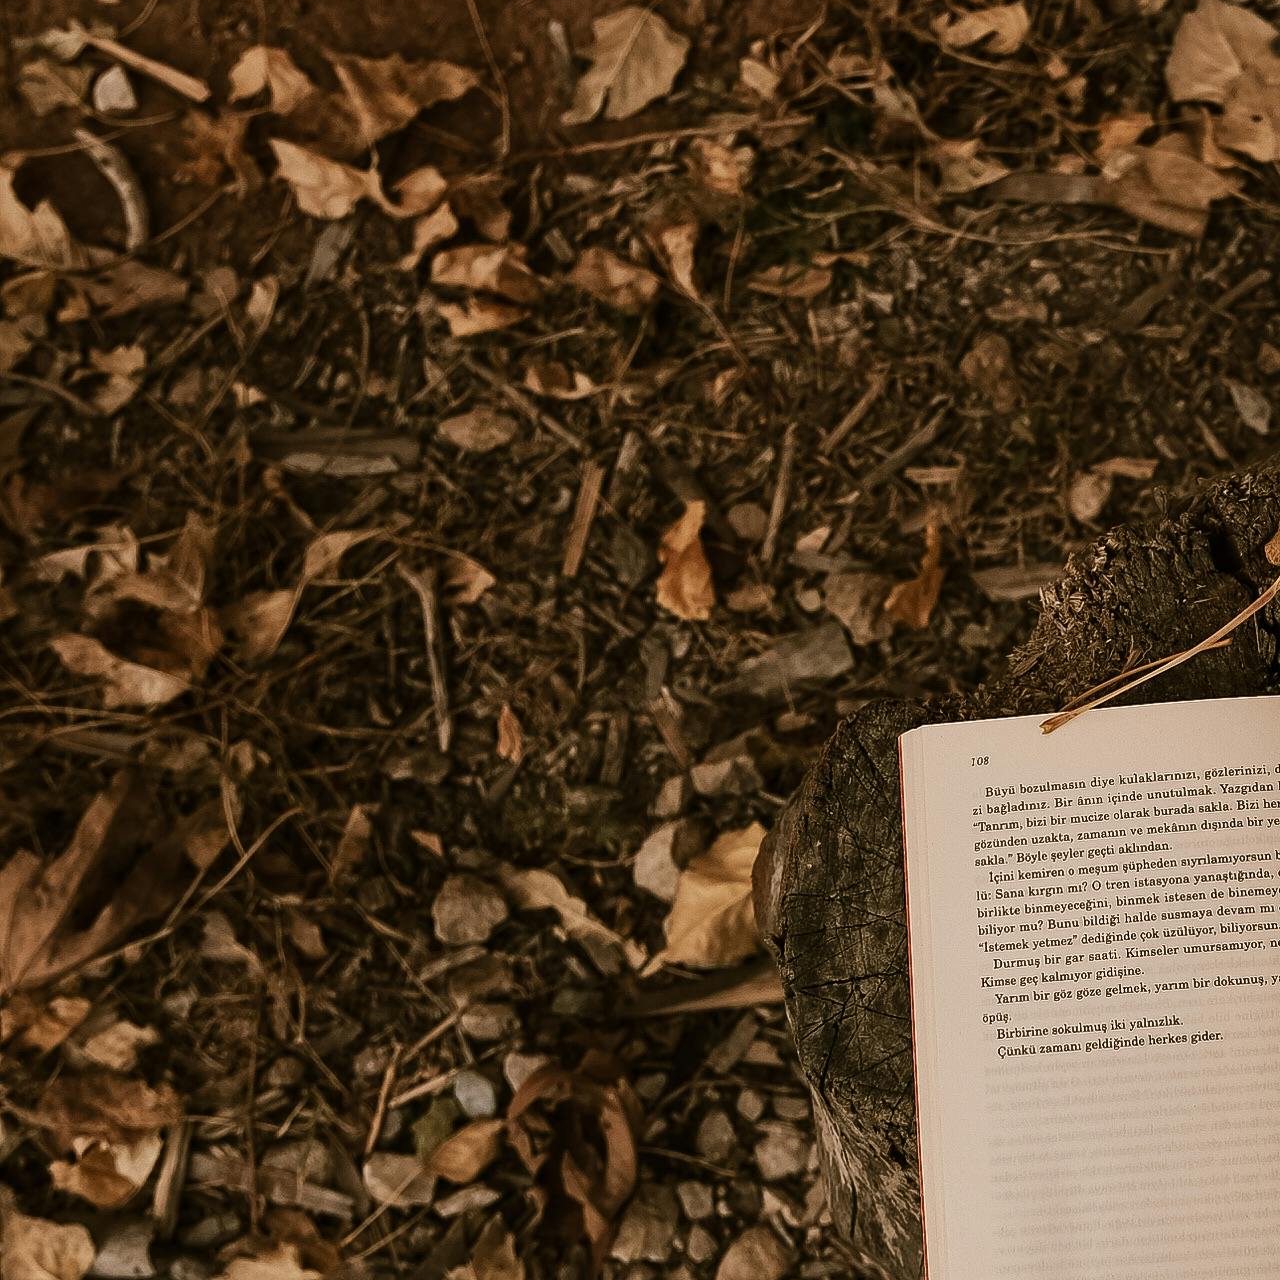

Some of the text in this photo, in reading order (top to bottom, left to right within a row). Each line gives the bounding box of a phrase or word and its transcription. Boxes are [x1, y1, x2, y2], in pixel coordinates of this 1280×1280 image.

[971, 756, 989, 766] 108
[985, 785, 1016, 798] Büyü
[1019, 780, 1086, 794] bozulmasın
[1090, 776, 1115, 789] diye
[1119, 771, 1200, 785] kulaklarınızı,
[1204, 764, 1271, 781] gözlerinizi,
[972, 804, 982, 816] zi
[986, 800, 1050, 816] bağladınız.
[1054, 797, 1073, 808] Bir
[1077, 796, 1103, 806] ânın
[1107, 790, 1143, 806] içinde
[1146, 784, 1216, 800] unutulmak.
[1219, 781, 1274, 796] Yazgıdan
[1026, 816, 1047, 828] bizi
[1050, 815, 1067, 826] bir
[1070, 811, 1110, 824] mucize
[1113, 807, 1150, 820] olarak
[1153, 803, 1195, 817] burada
[1198, 801, 1233, 813] sakla.
[1236, 799, 1259, 811] Bizi
[1016, 850, 1048, 865] Böyle
[1051, 847, 1085, 863] şeyler
[1088, 844, 1115, 860] geçti
[1118, 840, 1172, 855] aklından.
[977, 905, 1021, 918] birlikte
[1024, 897, 1112, 914] binmeyeceğini,
[1116, 892, 1160, 907] binmek
[1164, 892, 1206, 903] istesen
[1210, 888, 1224, 899] de
[978, 923, 1016, 937] biliyor
[1019, 919, 1044, 932] mu?
[1047, 918, 1079, 930] Bunu
[1083, 913, 1121, 927] bildiği
[1124, 910, 1157, 924] halde
[1161, 909, 1213, 921] susmaya
[1217, 905, 1256, 917] devam
[1260, 905, 1275, 914] mı
[981, 965, 1145, 988] Kimse geç kalmıyor gidişine.
[994, 993, 1030, 1005] Yarım
[1033, 990, 1050, 1001] bir
[1053, 989, 1073, 1002] göz
[1076, 987, 1102, 1001] göze
[1105, 981, 1151, 998] gelmek,
[1154, 981, 1189, 994] yarım
[1192, 977, 1211, 989] bir
[1213, 975, 1268, 987] dokunuş,
[982, 1012, 1012, 1025] öpüş.
[997, 1014, 1183, 1040] Birbirine sokulmuş iki yalnızlık.
[997, 1030, 1223, 1060] Çünkü zamanı geldiğinde herkes gider.
